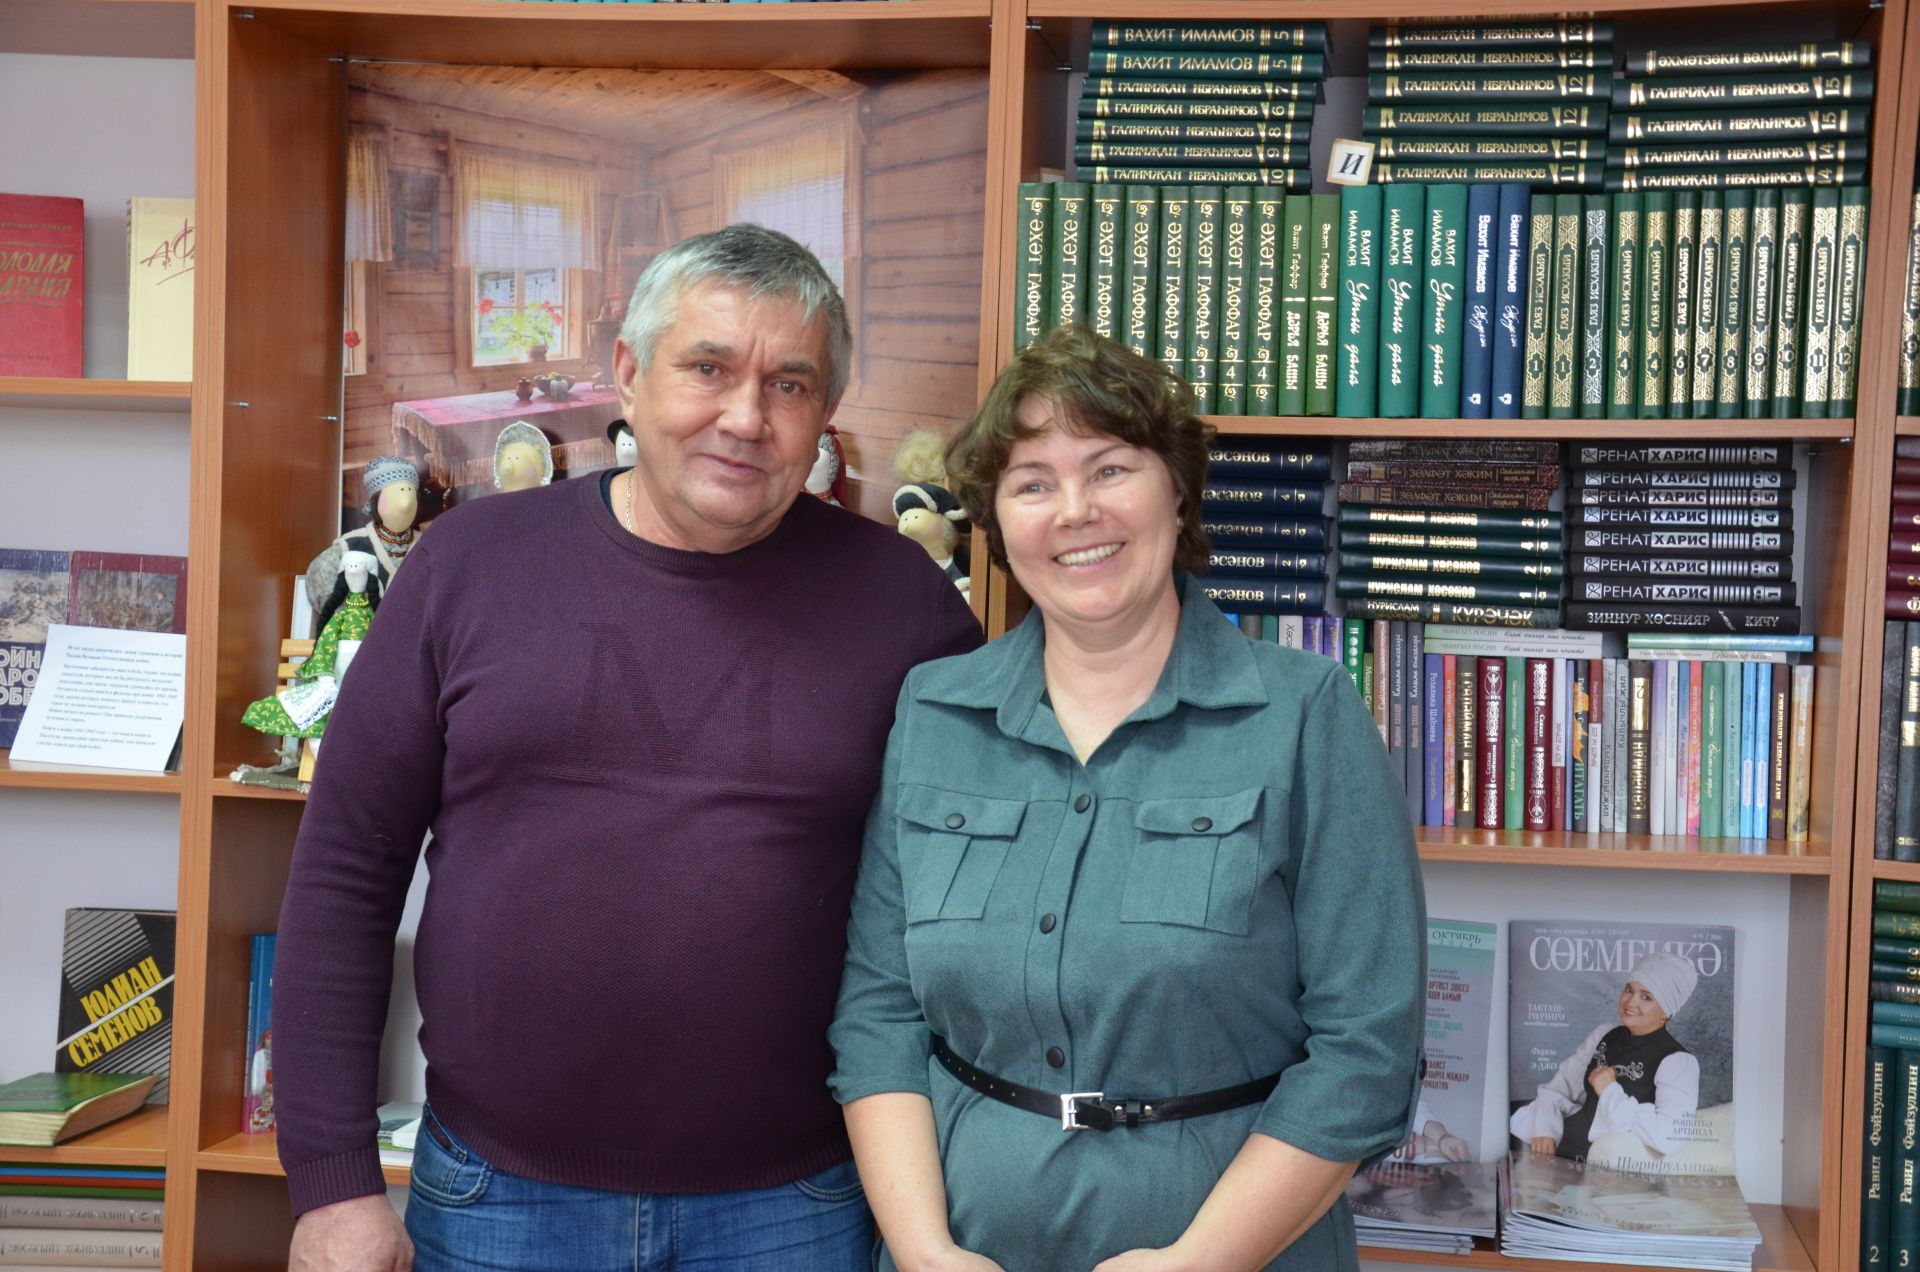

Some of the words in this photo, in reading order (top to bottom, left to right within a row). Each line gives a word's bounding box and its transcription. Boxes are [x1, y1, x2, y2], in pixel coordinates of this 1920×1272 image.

[1124, 28, 1176, 43] ВАХИТ
[1180, 27, 1254, 43] ИМАМОВ
[1273, 31, 1290, 41] 5
[1122, 57, 1175, 71] ВАХИТ
[1179, 56, 1253, 71] ИМАМОВ
[1272, 58, 1288, 69] 5
[1821, 50, 1839, 59] 1
[1274, 85, 1289, 96] 7
[1568, 74, 1585, 96] 12
[1823, 76, 1841, 97] 15
[1268, 126, 1283, 138] 8
[1562, 107, 1578, 126] 12
[1820, 111, 1837, 131] 15
[1337, 153, 1362, 176] И
[1562, 139, 1577, 159] 11
[1269, 168, 1285, 185] 10
[1029, 221, 1044, 266] ӘХӘТ
[1132, 221, 1148, 268] ӘХӘТ
[1166, 222, 1181, 268] ӘХӘТ
[1197, 222, 1213, 269] ӘХӘТ
[1229, 222, 1244, 269] ӘХӘТ
[1258, 222, 1275, 271] ӘХӘТ
[1347, 210, 1359, 267] ИМАМОВ
[1358, 229, 1371, 267] ВАХИТ
[1389, 210, 1402, 267] ИМАМОВ
[1401, 229, 1414, 267] ВАХИТ
[1431, 209, 1443, 267] ИМАМОВ
[1444, 229, 1457, 267] ВАХИТ
[1478, 214, 1491, 247] Вахит
[1508, 213, 1522, 247] Вахит
[1476, 248, 1489, 293] Имамов
[1507, 248, 1520, 293] Имамов
[1025, 273, 1043, 338] ГАФФАР
[1129, 274, 1147, 339] ГАФФАР
[1163, 275, 1180, 340] ГАФФАР
[1194, 275, 1211, 340] ГАФФАР
[1225, 275, 1243, 340] ГАФФАР
[1256, 275, 1274, 341] ГАФФАР
[1619, 304, 1630, 327] ГАЯЗ
[1676, 301, 1688, 324] ГАЯЗ
[1699, 299, 1711, 322] ГАЯЗ
[1727, 302, 1738, 325] ГАЯЗ
[1842, 298, 1855, 321] ГАЯЗ
[1286, 310, 1301, 348] ДӘРЬЯ
[1315, 310, 1330, 348] ДӘРЬЯ
[1197, 365, 1209, 379] 3
[1226, 366, 1236, 379] 4
[1258, 366, 1268, 380] 4
[1285, 354, 1300, 391] БАШЫ
[1314, 354, 1329, 391] БАШЫ
[1598, 449, 1649, 463] РЕНАТ
[1649, 449, 1705, 462] ХАРИС
[1764, 451, 1778, 460] 7
[1601, 509, 1650, 522] РЕНАТ
[1652, 510, 1707, 523] ХАРИС
[1765, 513, 1778, 522] 4
[1601, 533, 1651, 546] РЕНАТ
[1653, 533, 1708, 547] ХАРИС
[1766, 536, 1778, 546] 3
[1367, 601, 1420, 613] НУРИСЛАМ
[1602, 585, 1652, 599] РЕНАТ
[1654, 586, 1709, 600] ХАРИС
[1586, 611, 1641, 625] ЗИННУР
[1574, 762, 1585, 820] ИТАГАТЬ
[80, 955, 163, 1023] ЮЛИАН
[68, 995, 162, 1068] СЕМЕНОВ
[1869, 1061, 1884, 1146] Фәйзуллин
[1902, 1064, 1919, 1150] Фәйзуллин
[1868, 1155, 1881, 1200] Равил
[1899, 1159, 1913, 1204] Равил
[1869, 1244, 1879, 1263] 2
[1899, 1248, 1909, 1267] 3
